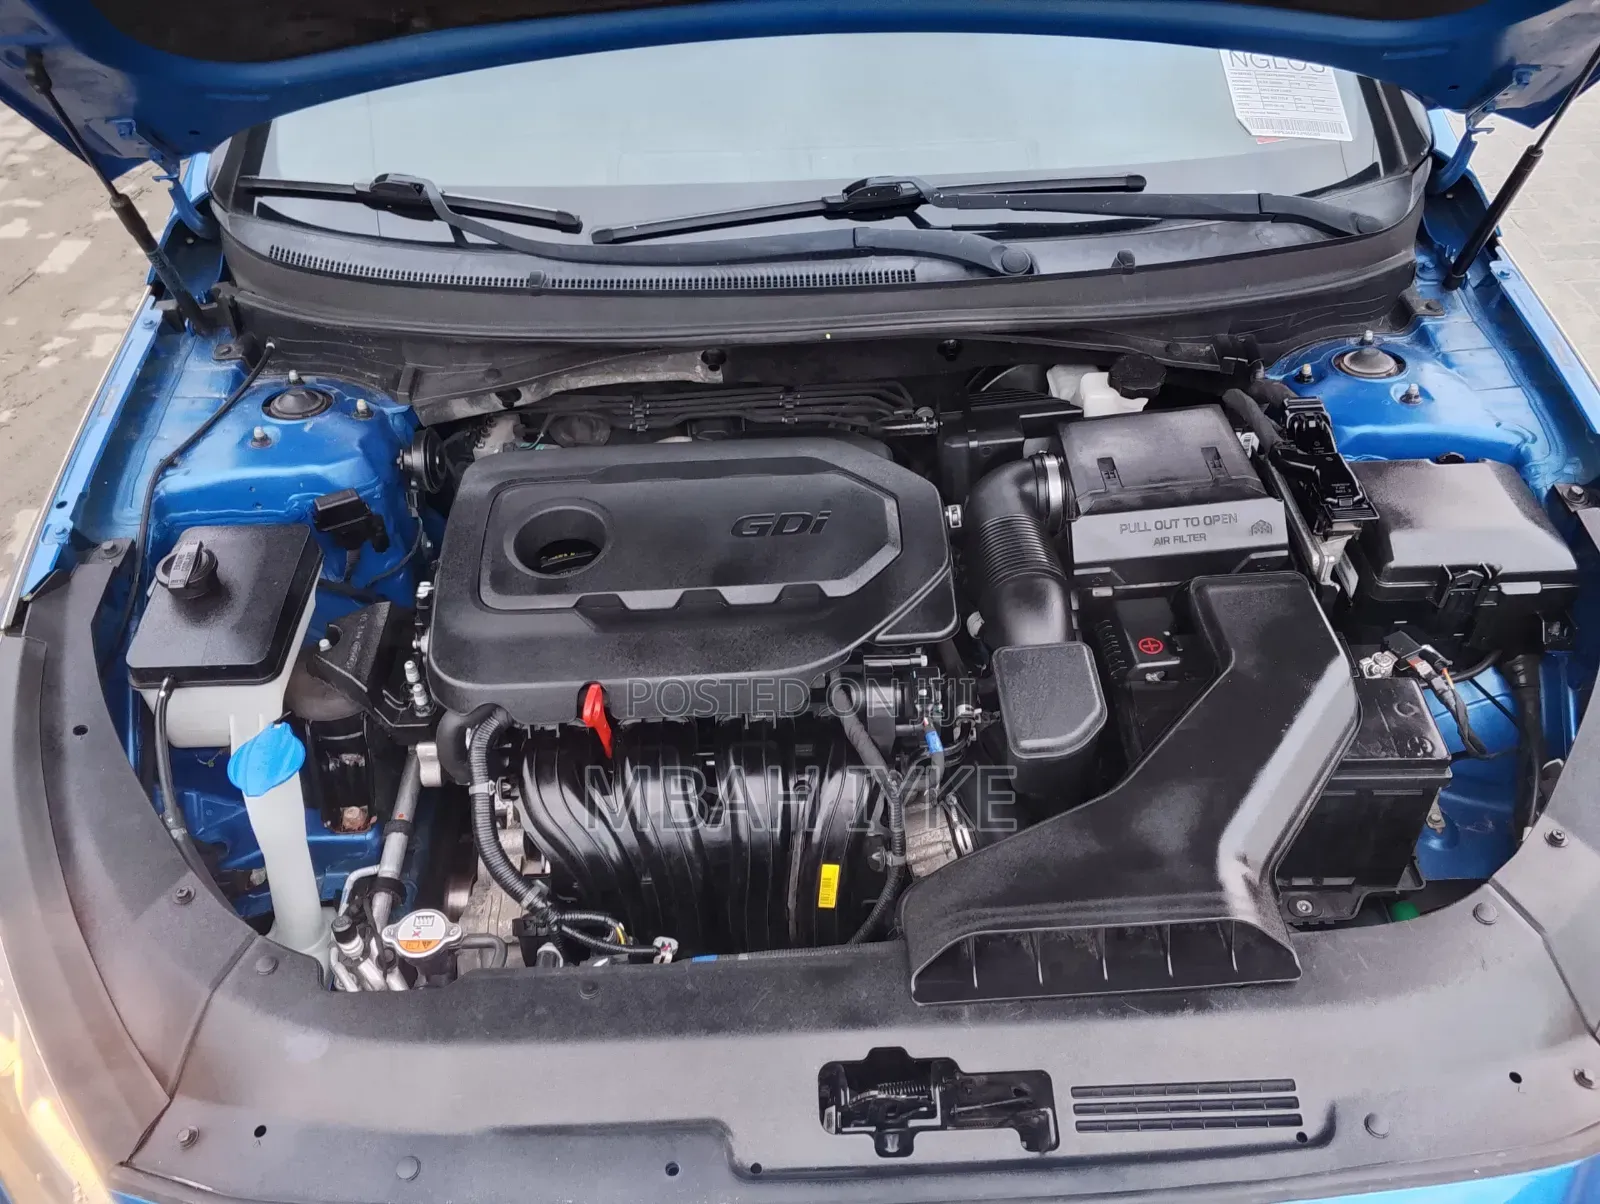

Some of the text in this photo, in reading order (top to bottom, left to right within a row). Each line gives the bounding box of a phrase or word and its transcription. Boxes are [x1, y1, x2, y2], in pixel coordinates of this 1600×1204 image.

[730, 510, 831, 537] GDi
[1119, 512, 1238, 535] PULL OUT TO OPEN
[1153, 532, 1207, 547] AIR FILTER
